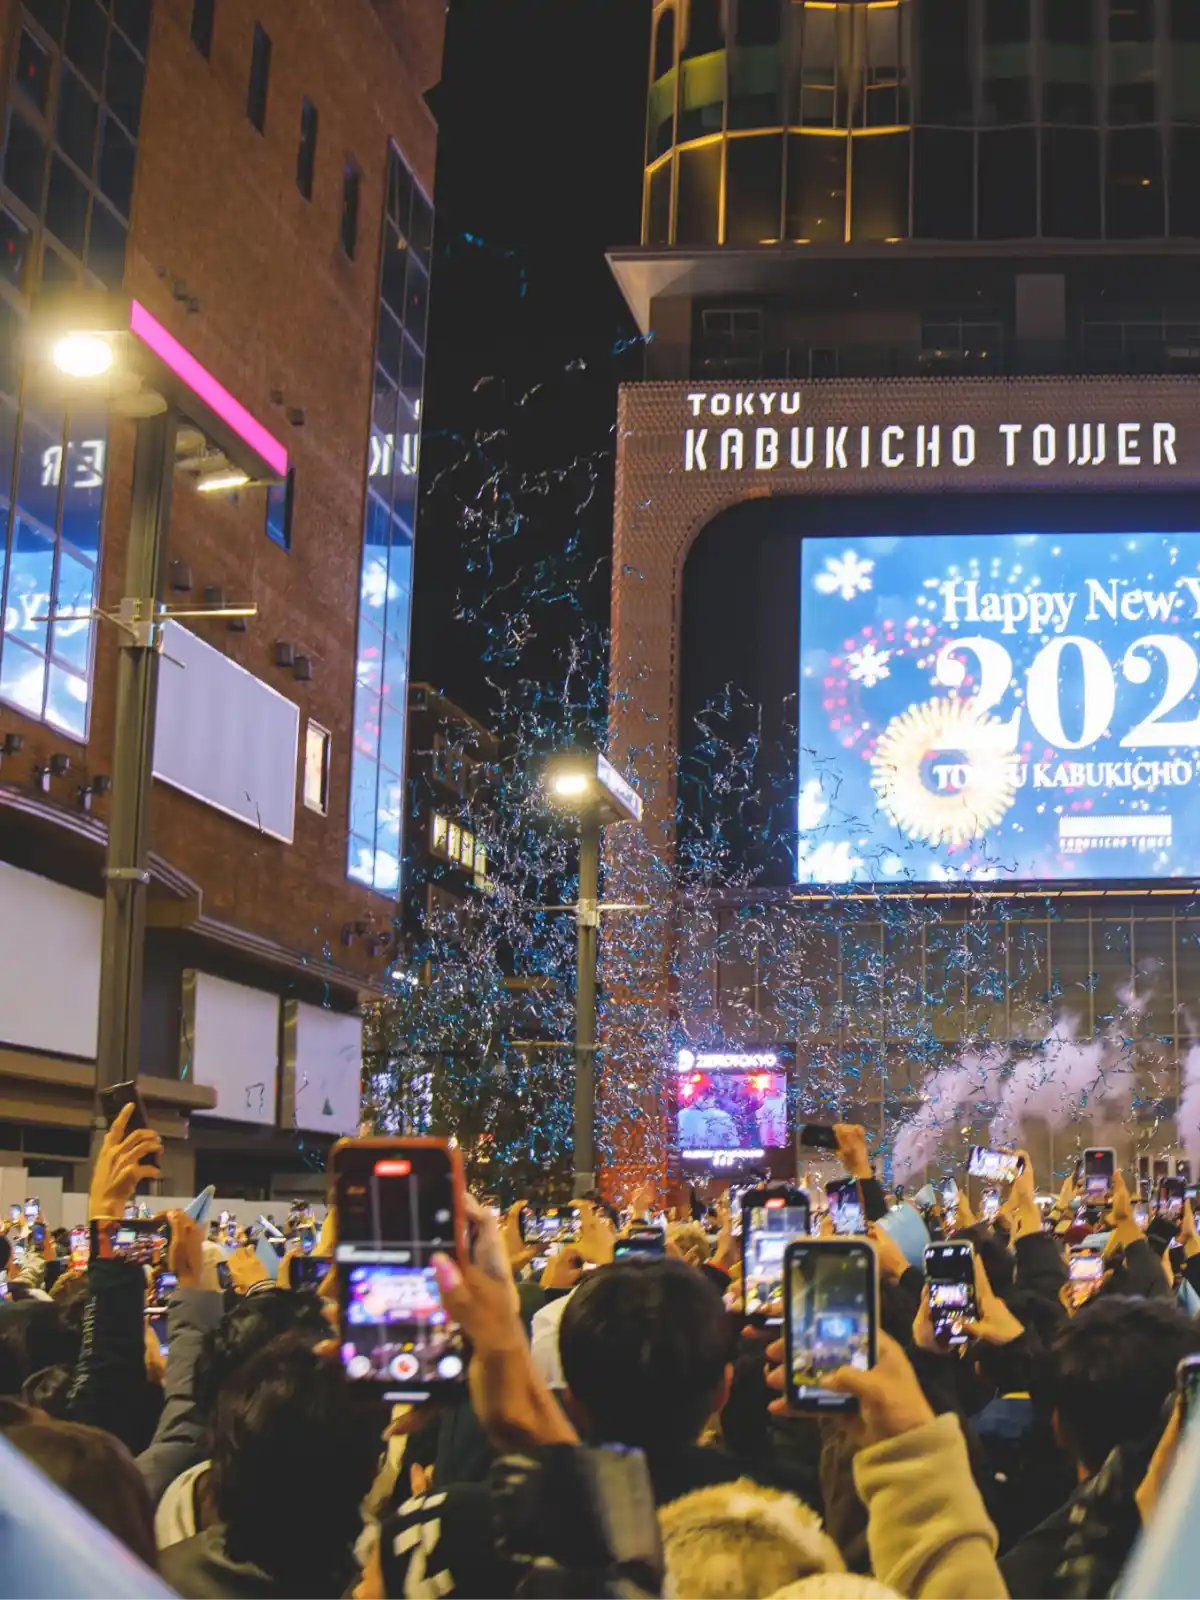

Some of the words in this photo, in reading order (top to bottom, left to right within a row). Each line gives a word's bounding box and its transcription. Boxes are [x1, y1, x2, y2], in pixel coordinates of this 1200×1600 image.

[687, 391, 800, 417] TOKYU
[684, 424, 976, 471] KABUKICHO
[999, 422, 1177, 468] TOWER
[942, 578, 1077, 634] Happy
[1084, 578, 1179, 622] New
[932, 762, 1027, 790] TOU
[1032, 759, 1192, 788] KABUKICHO
